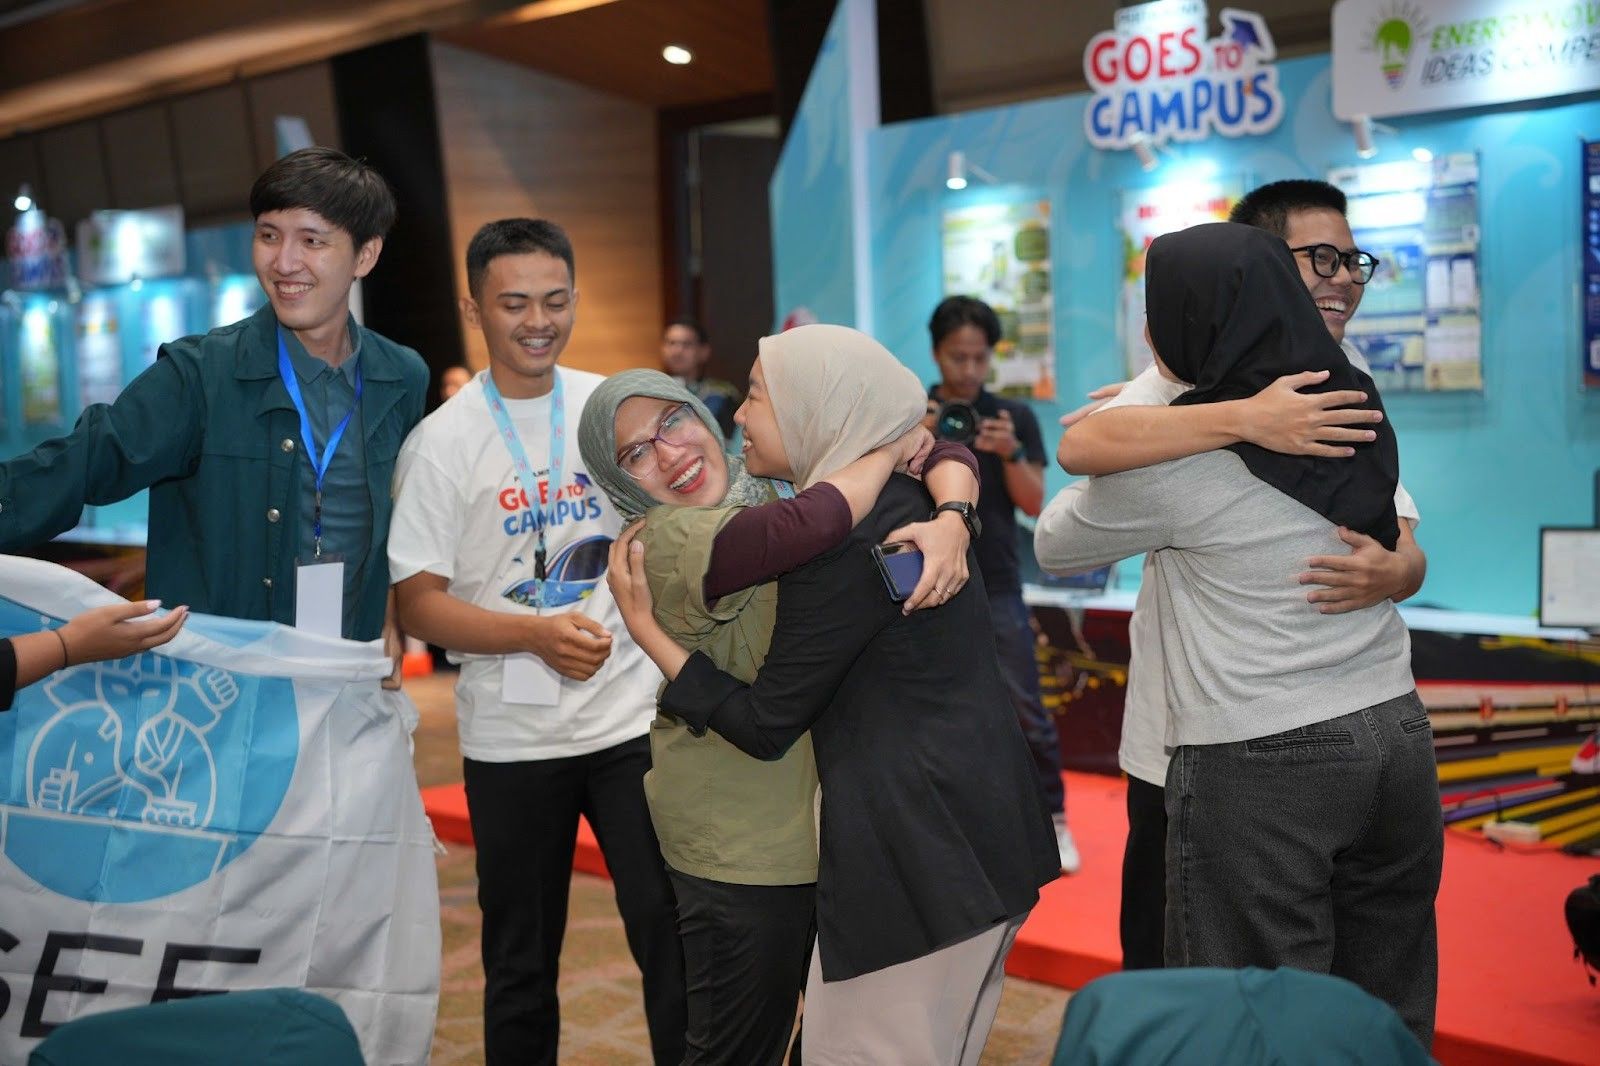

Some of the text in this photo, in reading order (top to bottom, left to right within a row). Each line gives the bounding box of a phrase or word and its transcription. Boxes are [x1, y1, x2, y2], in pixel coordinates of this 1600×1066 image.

[1091, 28, 1243, 84] GOES TO
[1418, 49, 1495, 86] IDEAS
[1092, 73, 1273, 137] CAMPUS
[566, 484, 585, 498] TO
[503, 496, 602, 536] CAMPUS
